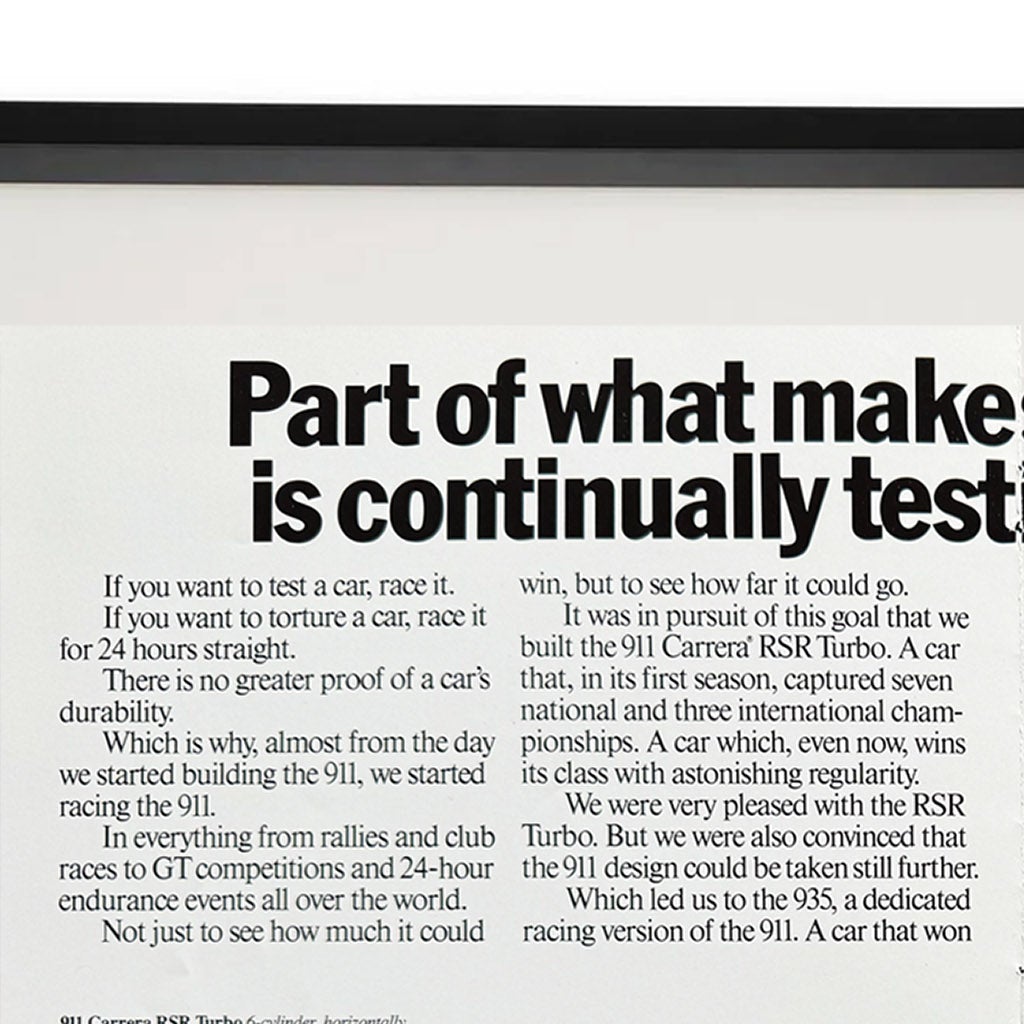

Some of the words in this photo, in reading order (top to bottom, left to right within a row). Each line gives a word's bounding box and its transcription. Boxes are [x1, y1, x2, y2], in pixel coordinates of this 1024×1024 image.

[230, 361, 419, 446] Part
[437, 359, 525, 445] of
[540, 359, 754, 443] what
[254, 461, 321, 543] is
[338, 453, 829, 558] continually
[104, 574, 123, 598] If
[128, 581, 170, 603] you
[176, 577, 233, 598] want
[240, 577, 263, 598] to
[269, 577, 307, 597] test
[314, 579, 327, 597] a
[333, 579, 372, 601] car,
[379, 578, 427, 596] race
[433, 572, 454, 595] it.
[520, 697, 617, 721] national
[624, 698, 668, 722] and
[674, 698, 733, 722] three
[739, 698, 885, 722] international
[891, 699, 963, 723] cham-
[102, 730, 179, 754] Which
[186, 731, 203, 755] is
[208, 731, 258, 759] why,
[265, 731, 343, 754] almost
[348, 729, 406, 753] from
[412, 730, 449, 753] the
[454, 730, 496, 758] day
[522, 760, 548, 784] its
[554, 761, 609, 785] class
[614, 760, 665, 784] with
[672, 761, 803, 790] astonishing
[809, 761, 919, 790] regularity.
[521, 823, 598, 848] Turbo.
[606, 823, 648, 847] But
[654, 830, 686, 848] we
[692, 830, 745, 848] were
[751, 824, 797, 848] also
[803, 824, 915, 848] convinced
[922, 824, 967, 848] that
[58, 888, 179, 912] endurance
[185, 891, 256, 911] events
[261, 887, 289, 911] all
[295, 893, 345, 911] over
[351, 887, 388, 911] the
[392, 887, 467, 911] world.
